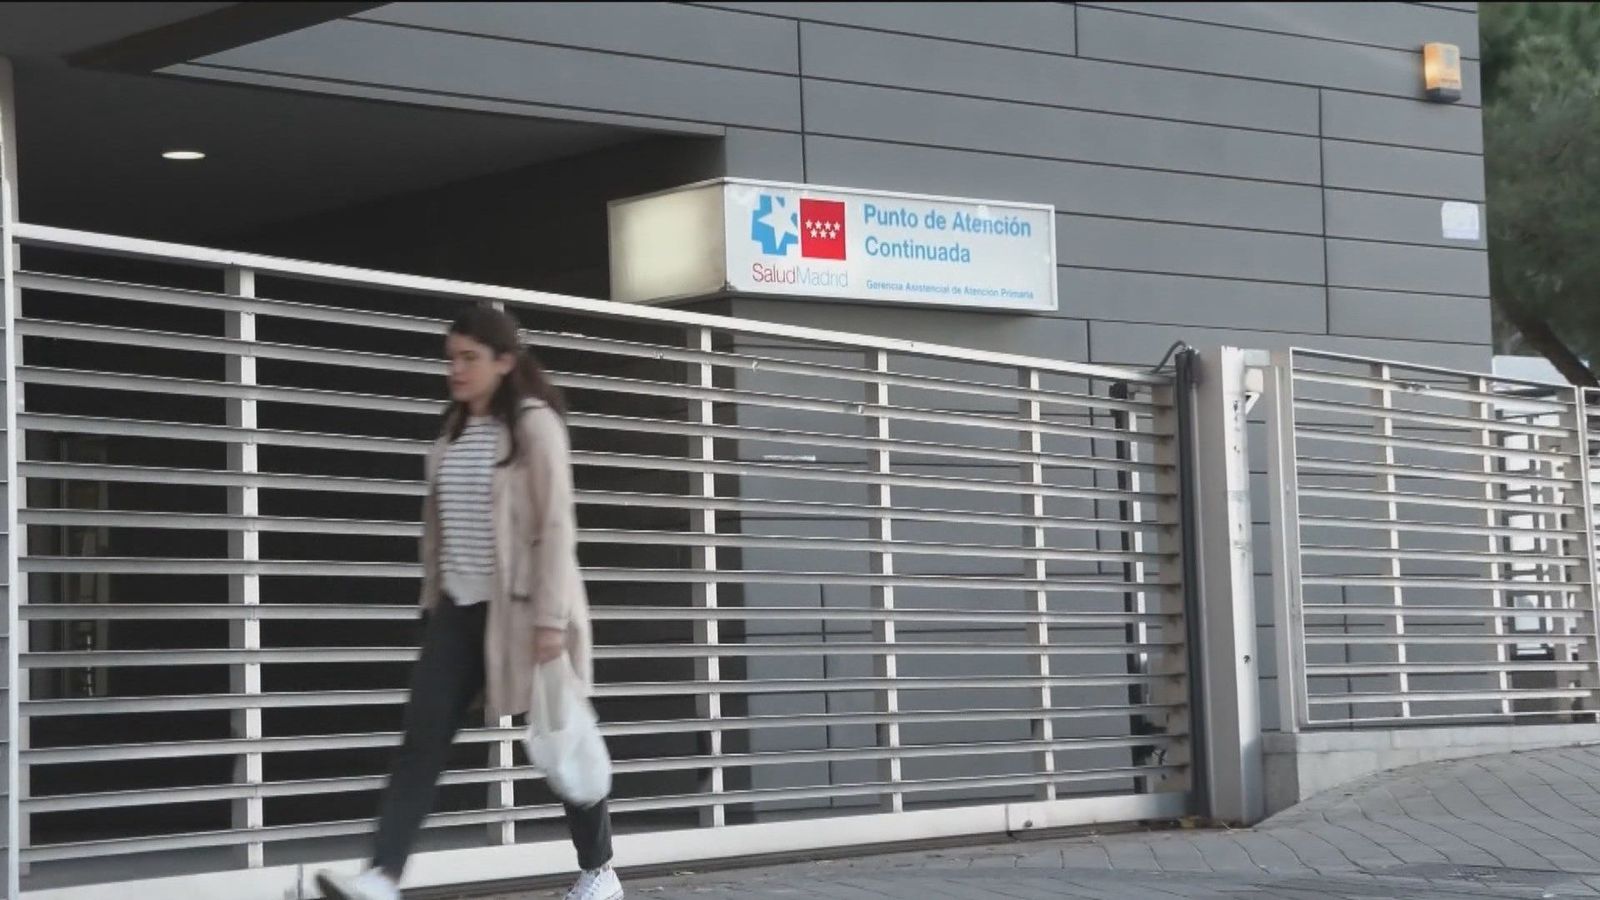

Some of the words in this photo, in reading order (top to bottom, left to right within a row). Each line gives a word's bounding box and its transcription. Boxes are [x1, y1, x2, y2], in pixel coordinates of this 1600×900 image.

[864, 204, 918, 228] Punto
[924, 210, 946, 230] de
[952, 211, 1031, 236] Atención
[865, 236, 971, 263] Continuada
[866, 280, 903, 291] Gerencia
[906, 282, 950, 294] Asistencial
[952, 285, 962, 295] de
[964, 286, 998, 297] Atención
[1001, 288, 1034, 299] Primaria
